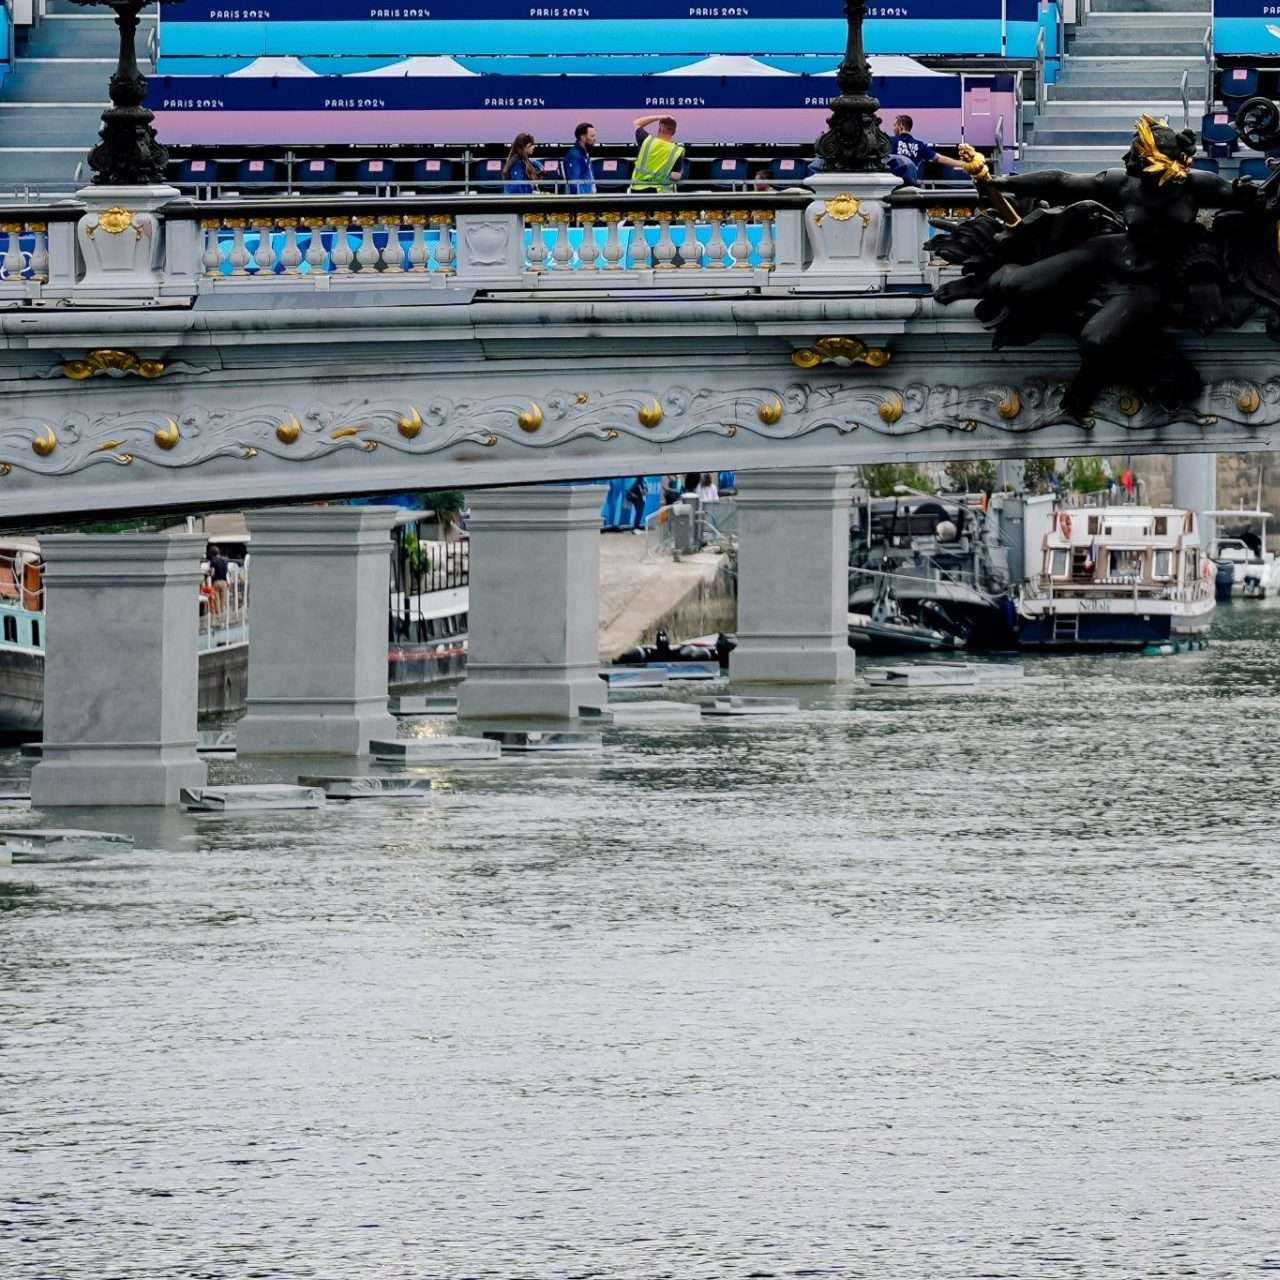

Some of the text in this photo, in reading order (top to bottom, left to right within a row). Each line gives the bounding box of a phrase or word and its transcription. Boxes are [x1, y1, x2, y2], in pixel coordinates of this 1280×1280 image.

[243, 10, 270, 19] 2024
[403, 9, 430, 18] 2024
[563, 8, 590, 17] 2024
[722, 7, 749, 16] 2024
[880, 7, 907, 16] 2024
[196, 99, 223, 108] 2024
[357, 98, 384, 108] 2024
[517, 98, 544, 107] 2024
[678, 97, 705, 106] 2024
